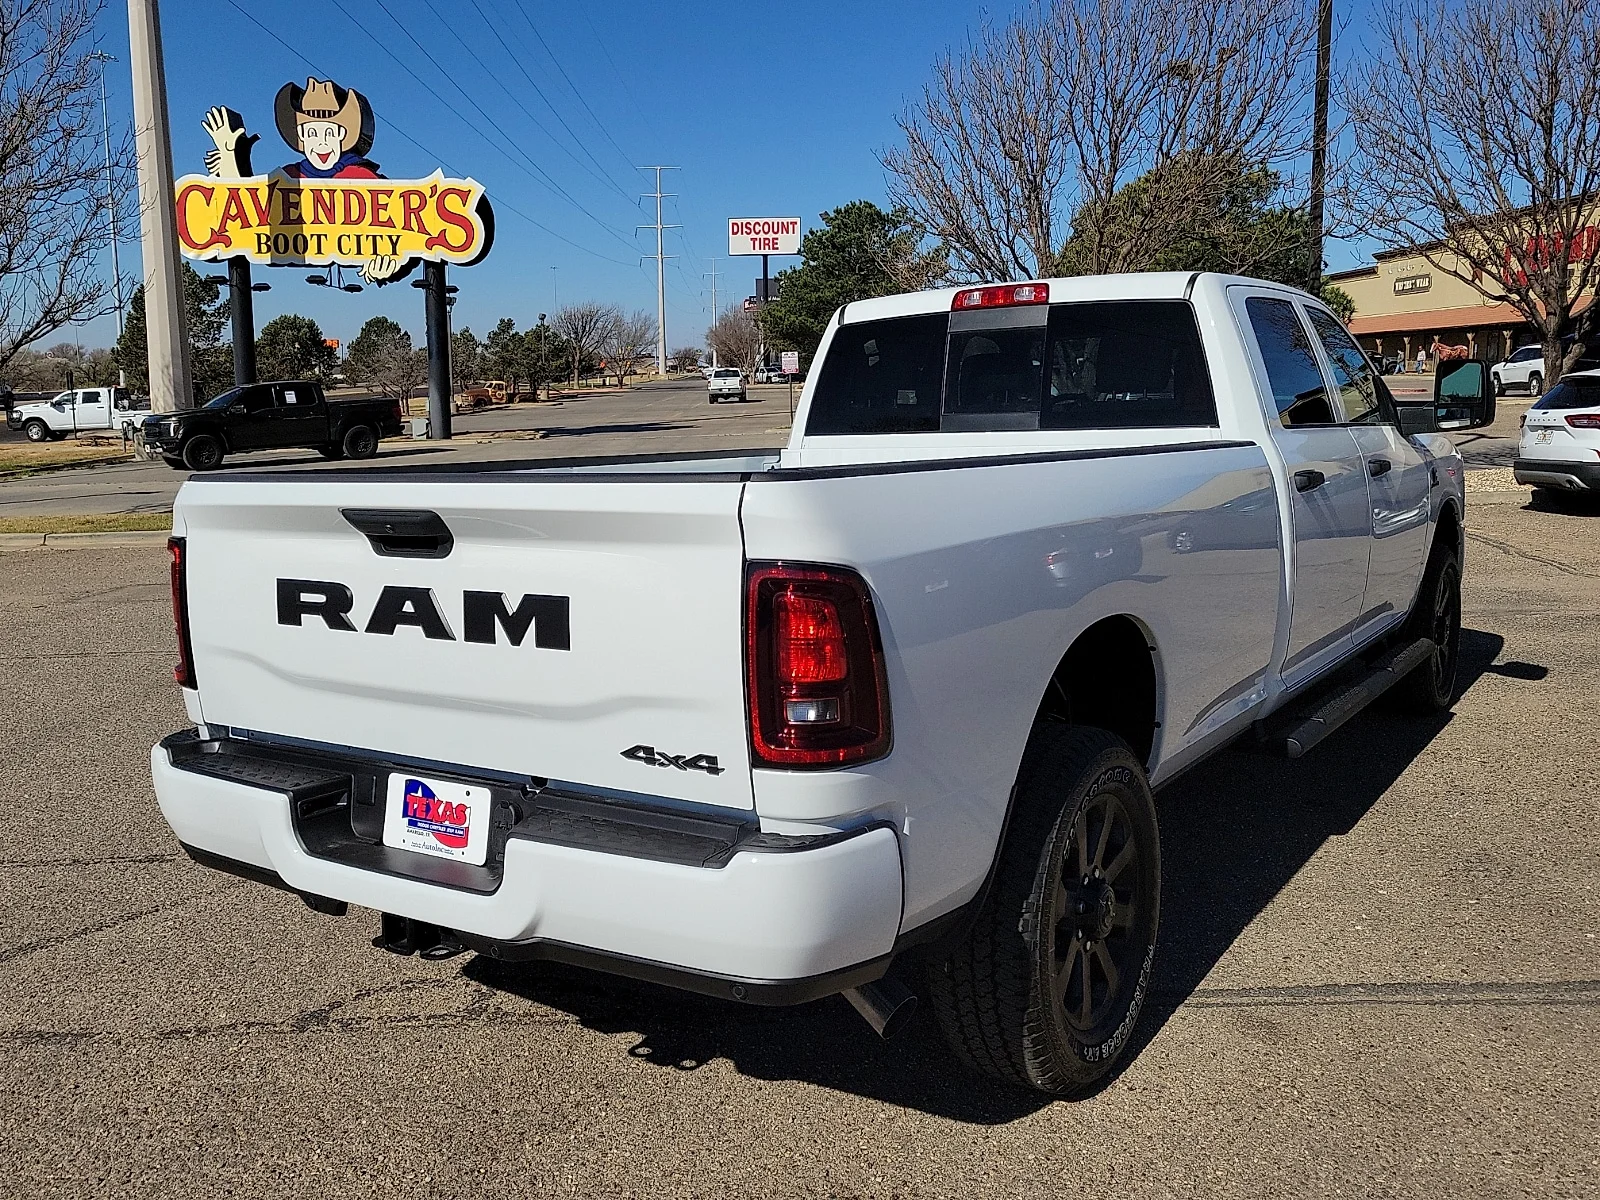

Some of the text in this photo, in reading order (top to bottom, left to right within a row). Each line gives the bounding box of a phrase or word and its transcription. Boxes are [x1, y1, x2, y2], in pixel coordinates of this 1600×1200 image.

[177, 179, 475, 252] CAVENDER'S
[731, 221, 797, 235] DISCOUNT
[255, 233, 402, 256] BOOT CITY
[750, 237, 779, 250] TIRE
[275, 577, 571, 651] RAM
[618, 744, 726, 777] 4x4
[406, 793, 468, 826] TEXAS
